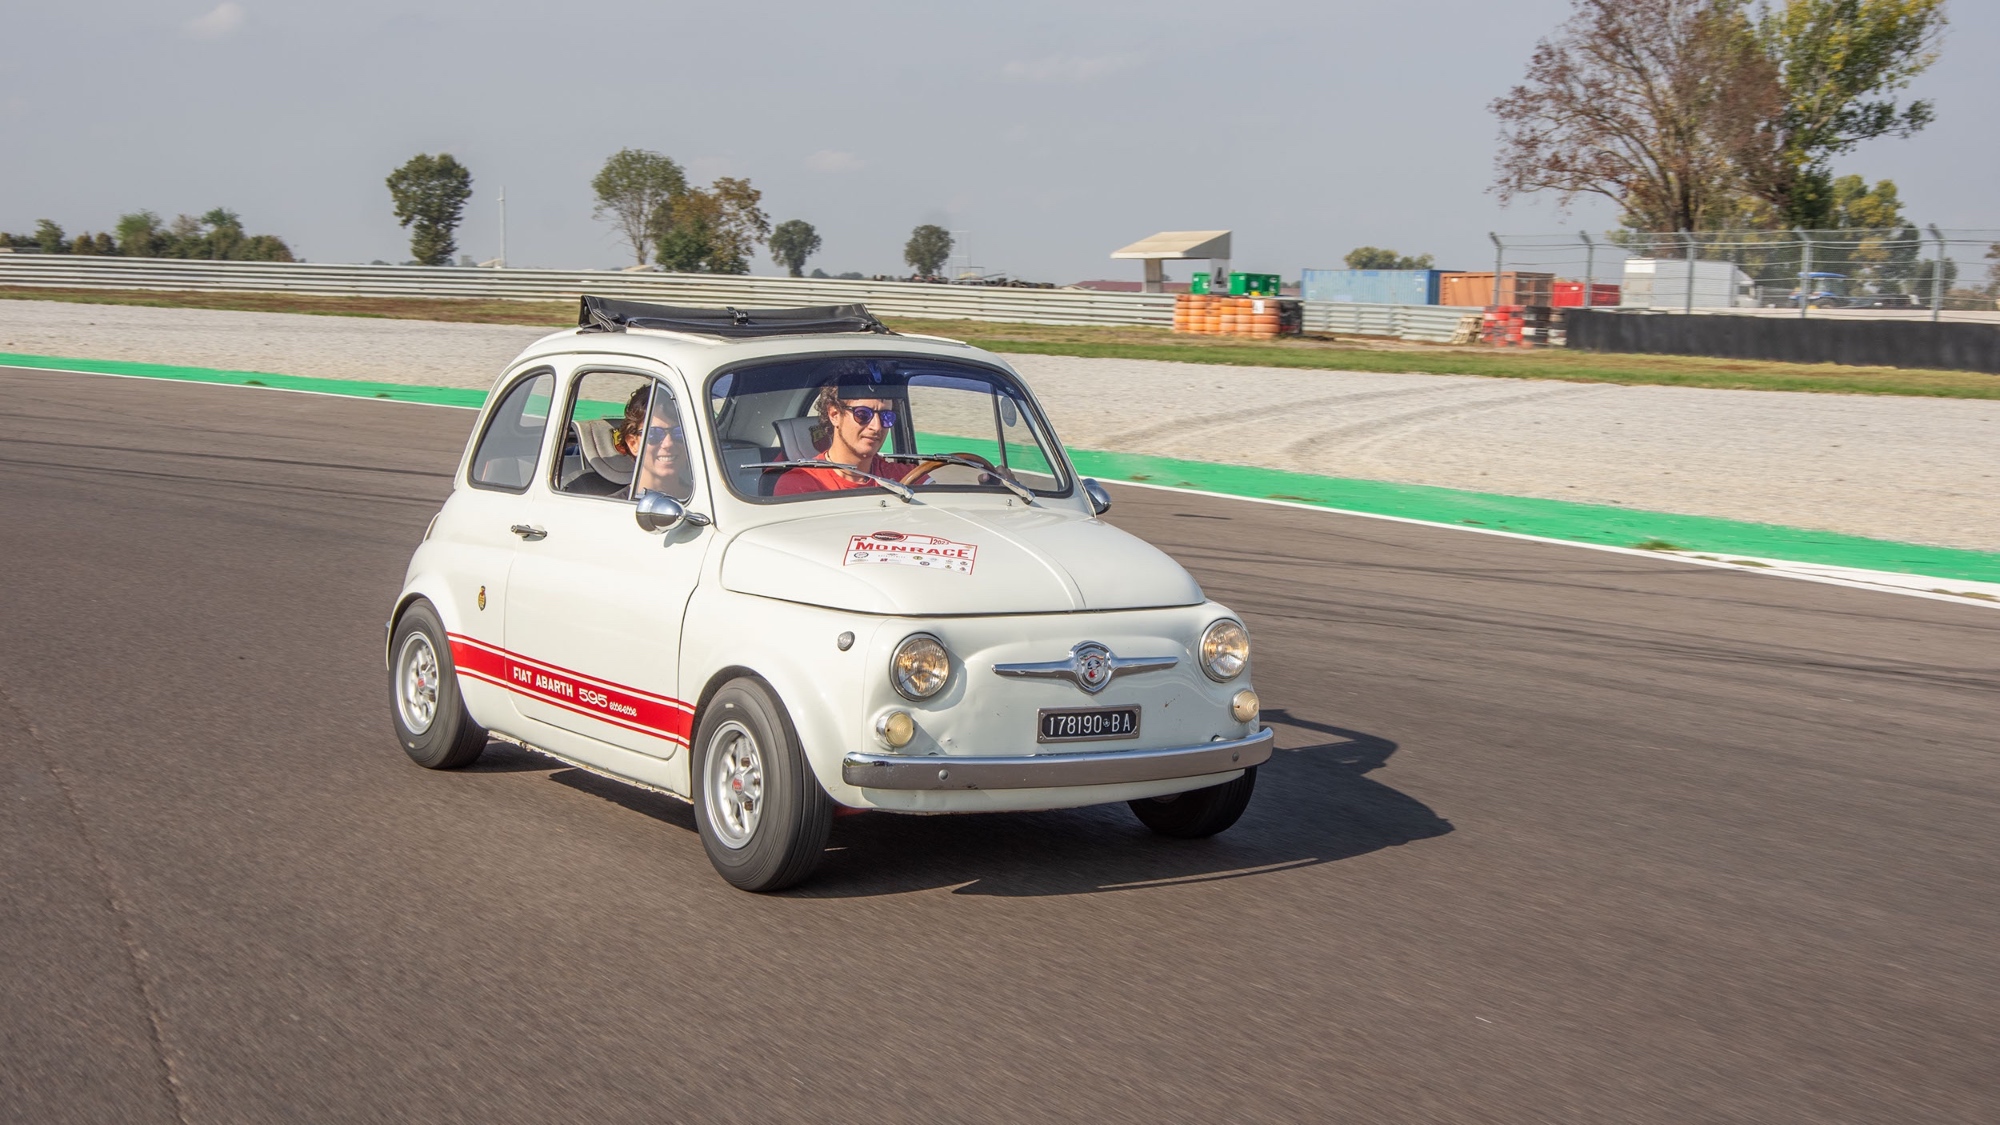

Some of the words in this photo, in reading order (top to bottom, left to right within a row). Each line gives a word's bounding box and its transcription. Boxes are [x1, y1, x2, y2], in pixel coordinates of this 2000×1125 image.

[855, 541, 970, 558] MONRACE
[513, 666, 532, 684] FIAT
[536, 674, 573, 698] ABARTH
[579, 687, 608, 708] 595
[1050, 715, 1102, 735] 178190
[1111, 713, 1131, 733] BA
